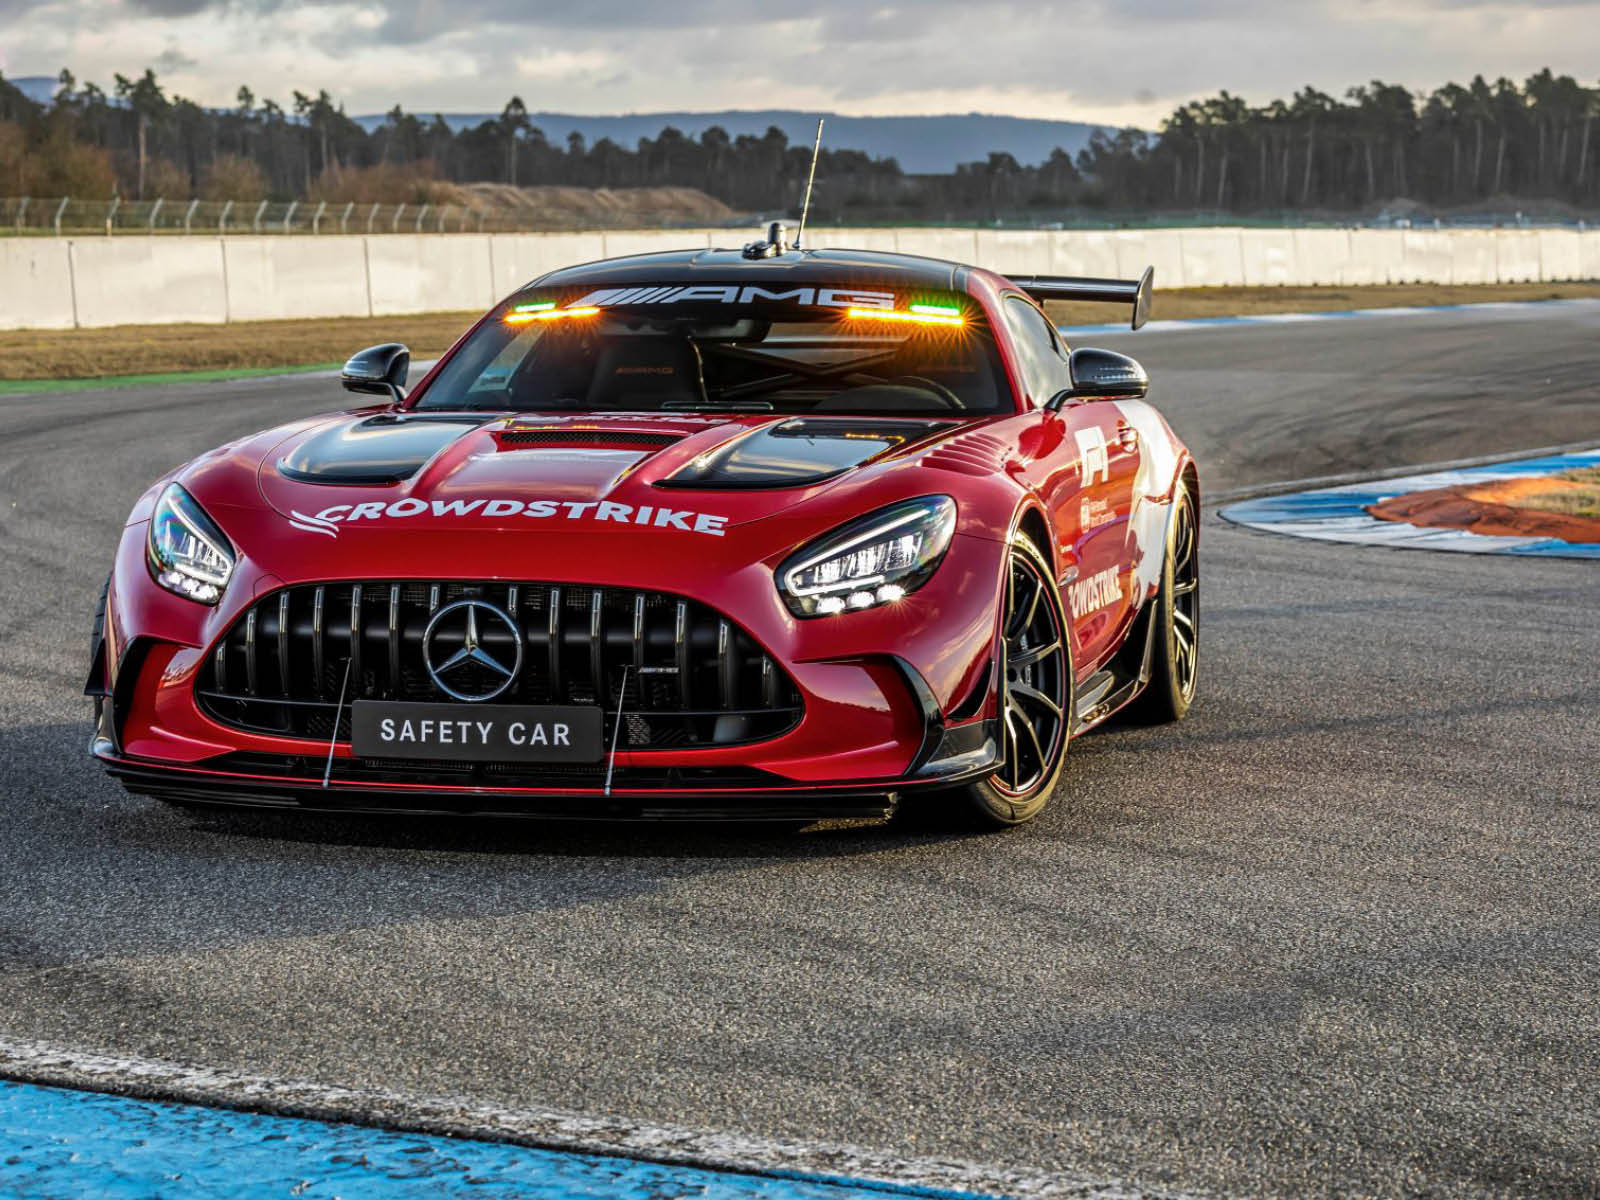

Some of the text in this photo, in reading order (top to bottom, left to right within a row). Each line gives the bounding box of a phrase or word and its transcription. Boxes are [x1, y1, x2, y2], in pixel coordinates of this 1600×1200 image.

[659, 286, 895, 310] AMG
[317, 498, 729, 537] CROWDSTRIKE
[380, 718, 571, 746] SAFETY CAR
